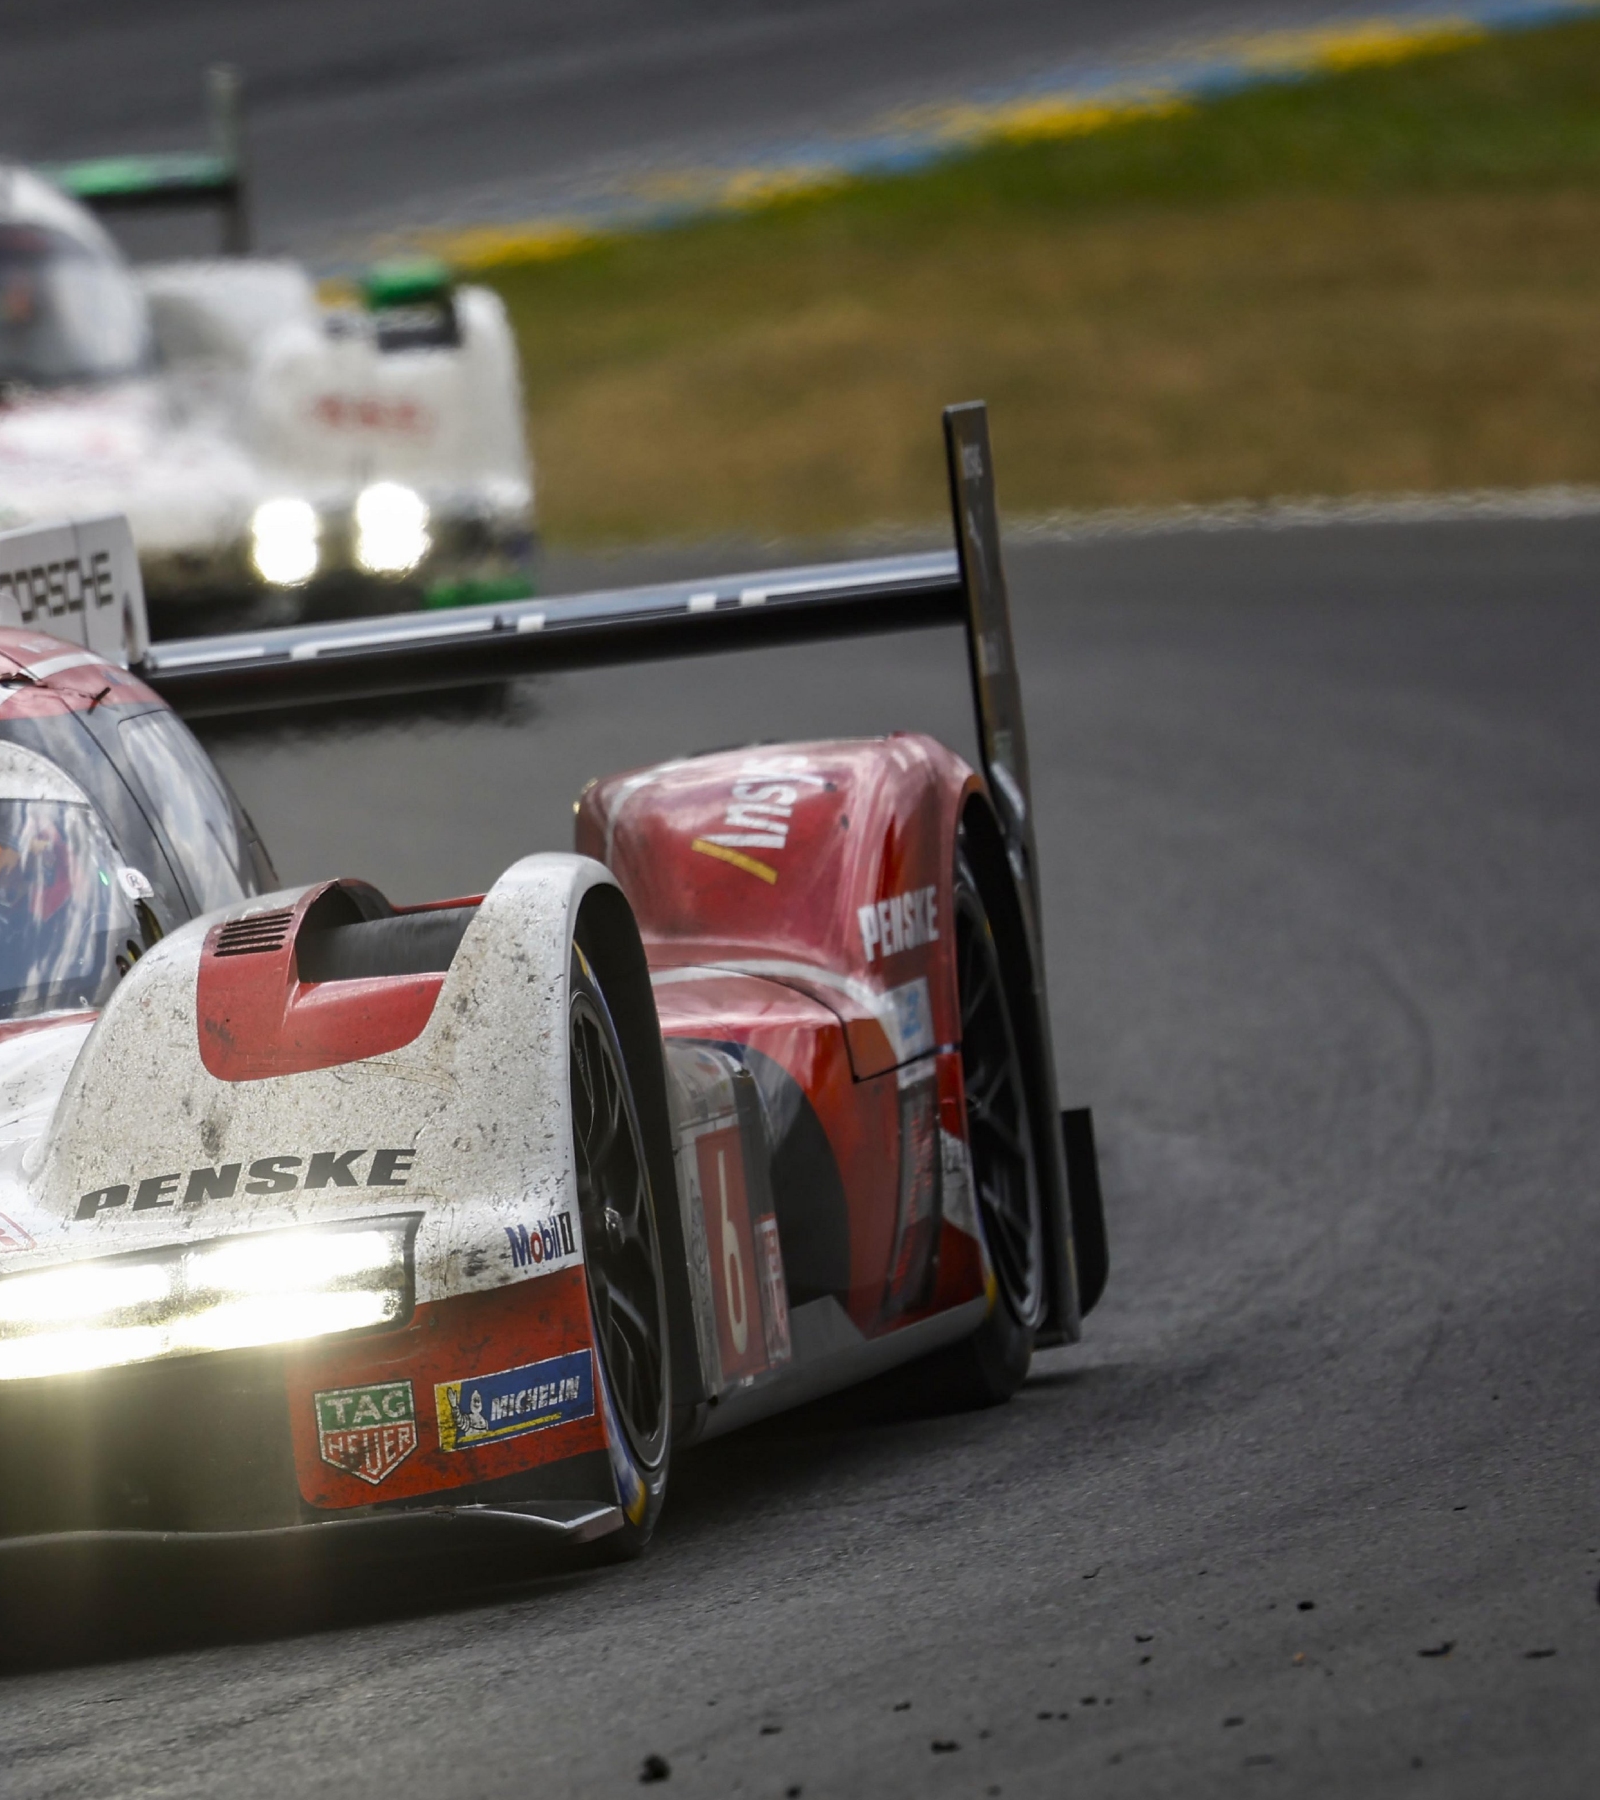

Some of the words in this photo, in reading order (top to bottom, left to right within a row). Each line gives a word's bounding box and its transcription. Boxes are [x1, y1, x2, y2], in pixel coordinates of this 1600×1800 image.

[858, 885, 940, 962] PENSKE
[75, 1149, 417, 1221] PENSKE
[717, 1150, 748, 1354] 6
[325, 1390, 406, 1424] TAG
[490, 1376, 580, 1421] MICHELIN
[328, 1427, 411, 1475] HEUER
